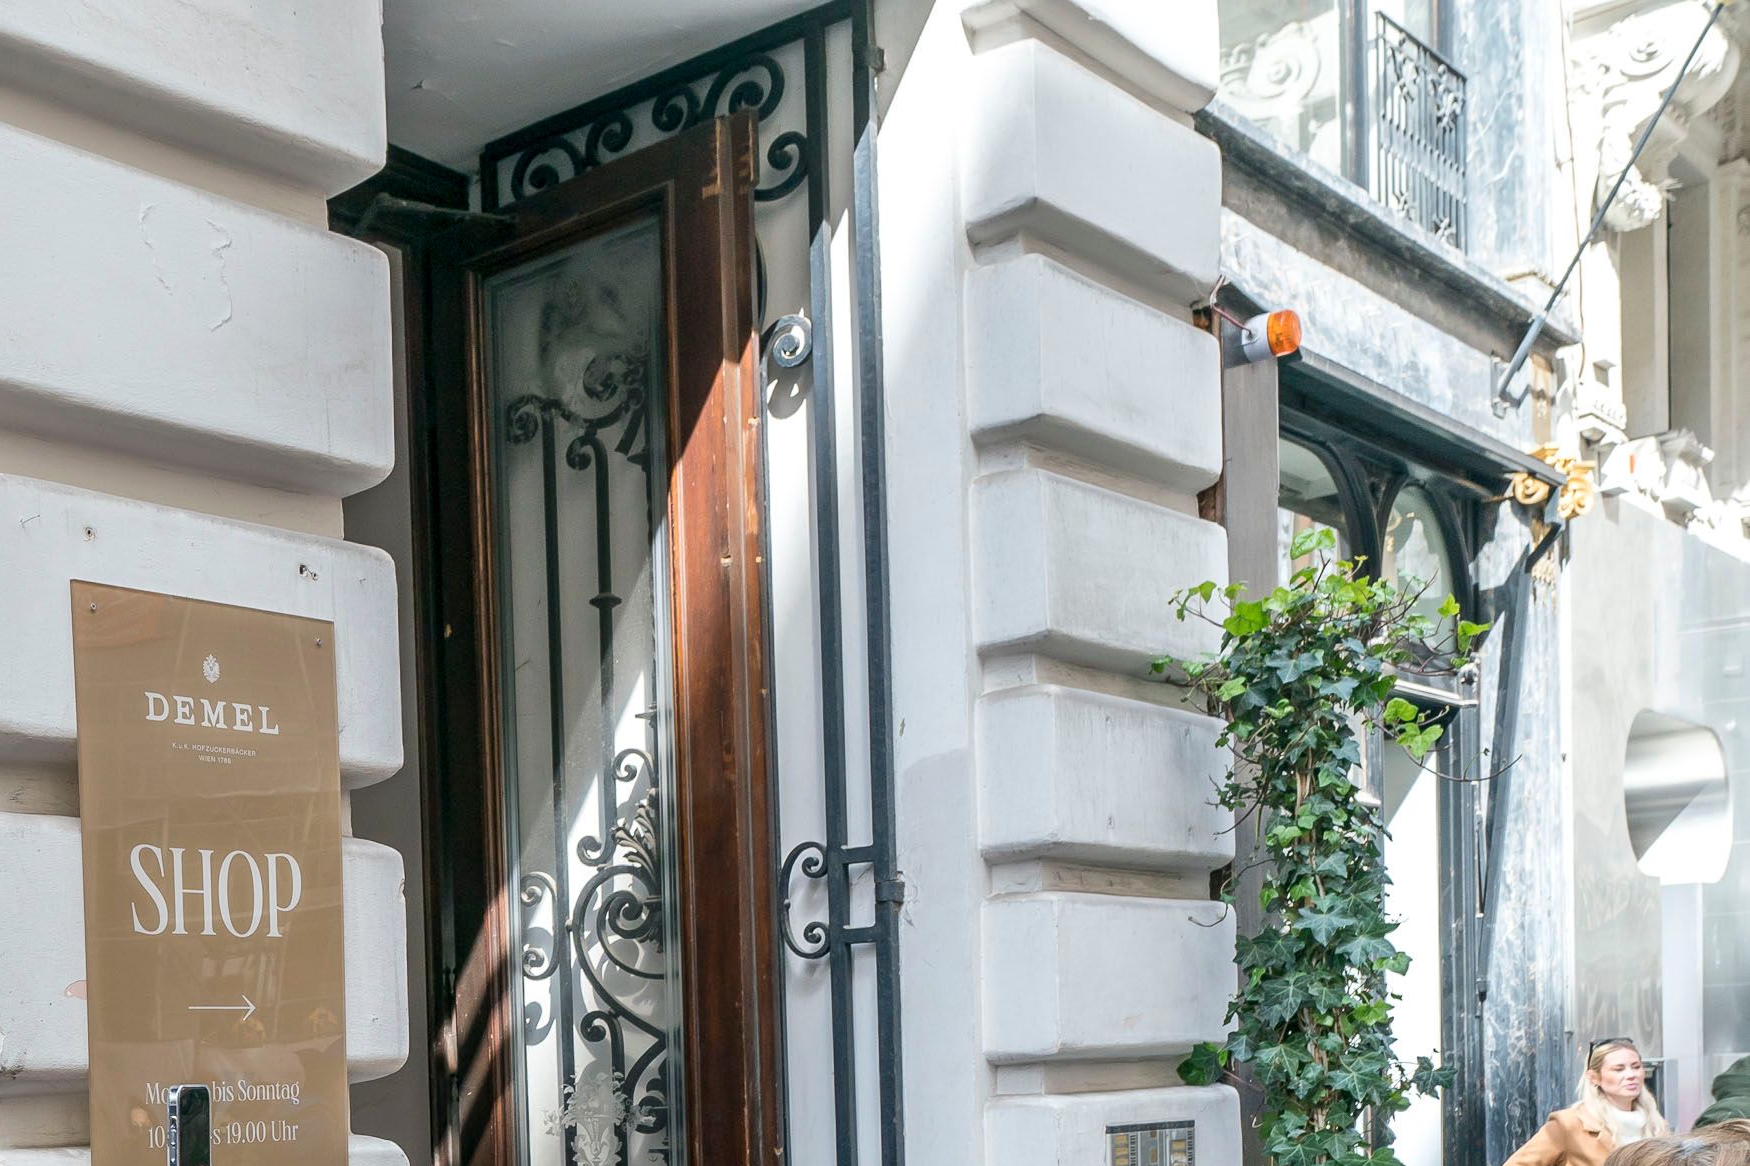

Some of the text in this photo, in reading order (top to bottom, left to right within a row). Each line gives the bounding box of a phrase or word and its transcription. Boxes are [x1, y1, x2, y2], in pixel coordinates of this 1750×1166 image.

[144, 691, 280, 735] DEMEL
[198, 754, 216, 763] WIEN
[129, 843, 303, 939] SHOP
[212, 1079, 300, 1105] bis Sonntag
[225, 1121, 267, 1145] 19.00
[270, 1120, 299, 1142] Uhr
